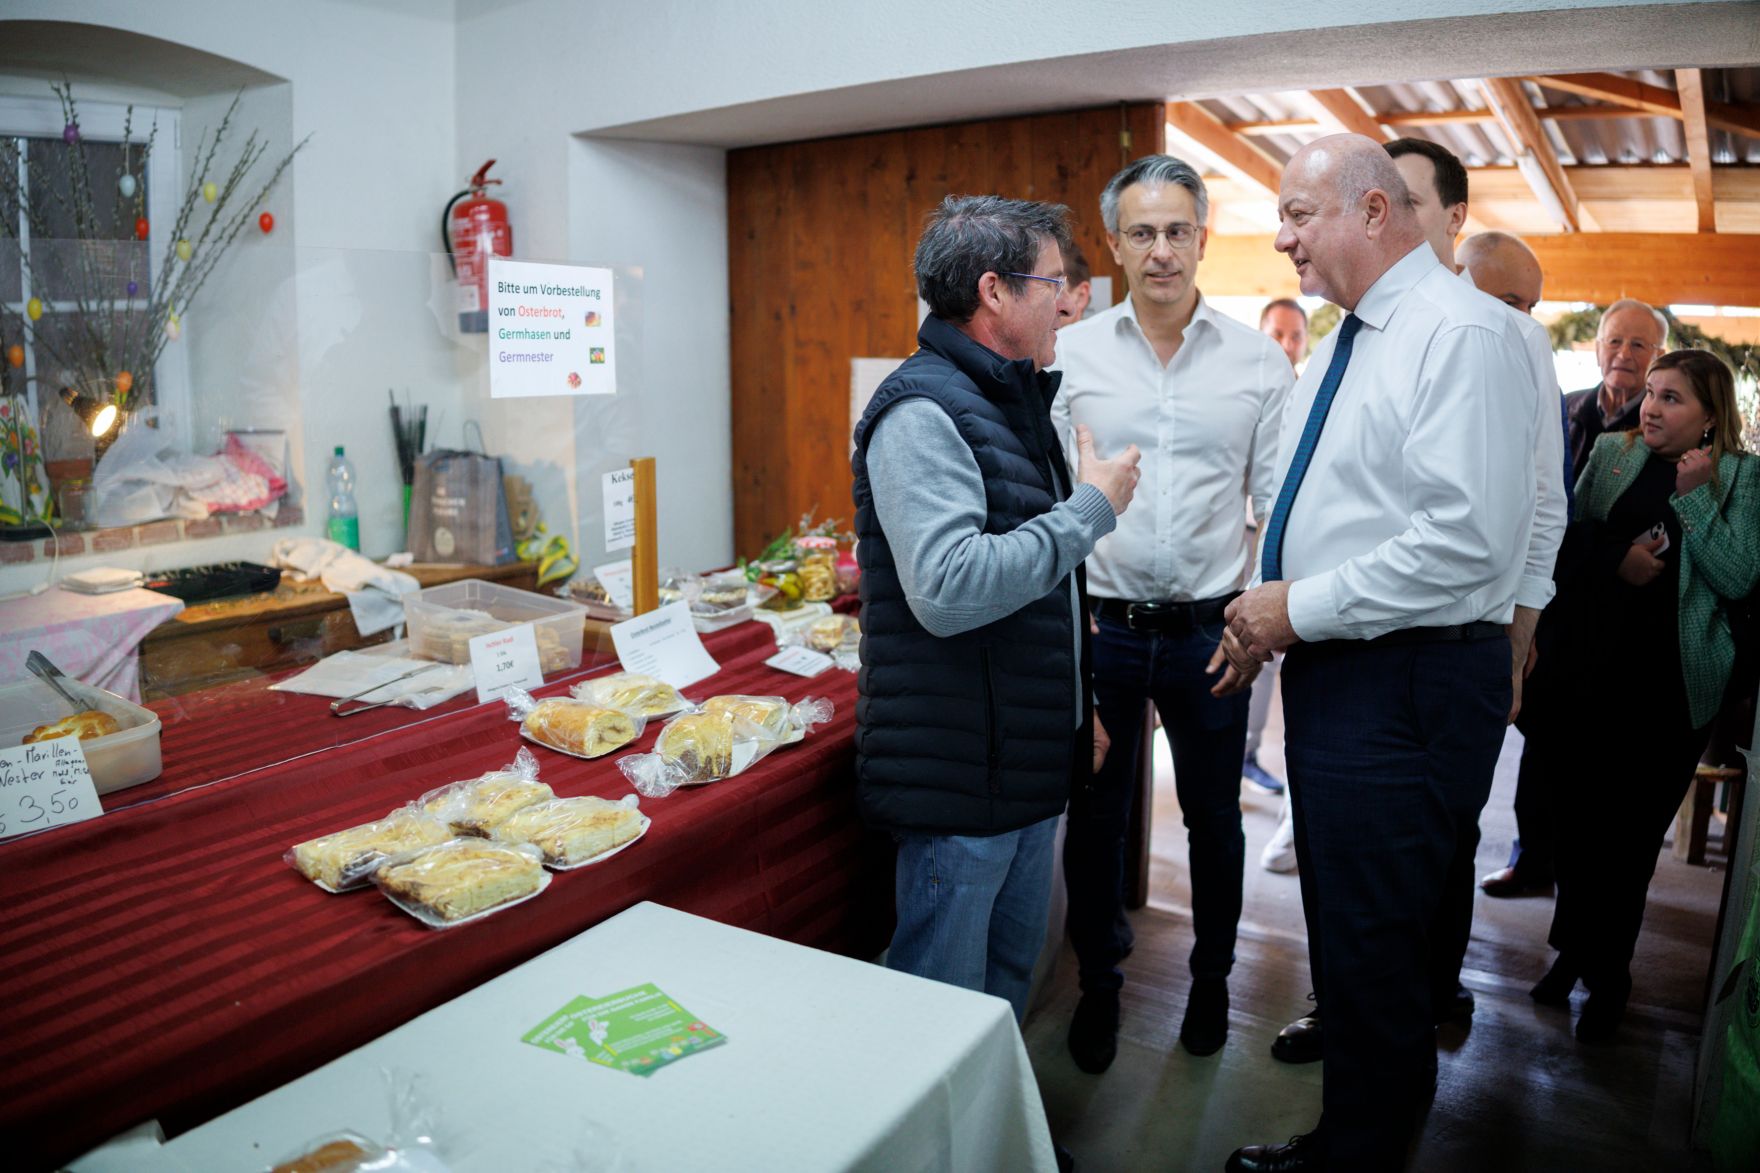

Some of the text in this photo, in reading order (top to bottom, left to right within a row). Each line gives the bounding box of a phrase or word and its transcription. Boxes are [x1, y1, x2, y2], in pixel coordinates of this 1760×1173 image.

[498, 281, 601, 300] Bitte um Vorbestellung
[498, 305, 565, 319] von Osterbrot,
[498, 328, 571, 340] Germhasen und
[499, 351, 554, 363] Germnester
[19, 789, 79, 824] 3,50
